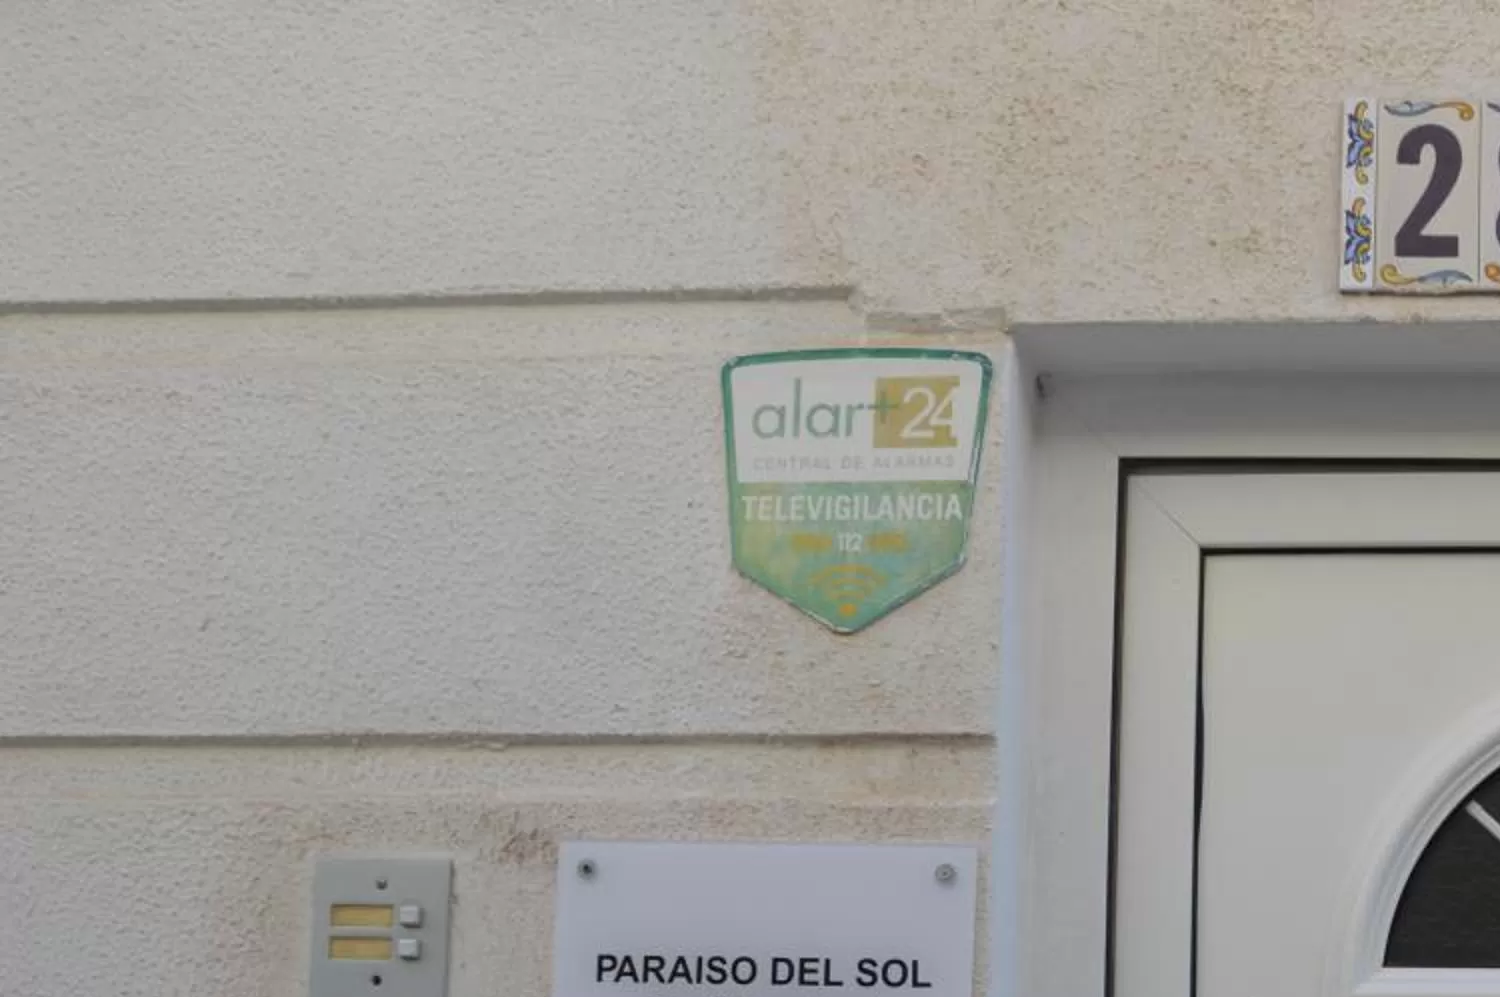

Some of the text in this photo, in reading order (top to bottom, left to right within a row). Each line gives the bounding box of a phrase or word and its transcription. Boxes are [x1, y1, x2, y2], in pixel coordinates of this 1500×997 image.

[753, 455, 831, 471] CENTRAL
[840, 454, 866, 470] DE
[741, 492, 964, 521] TELEVIGILANCIA
[595, 953, 932, 989] PARAISO DEL SOL
